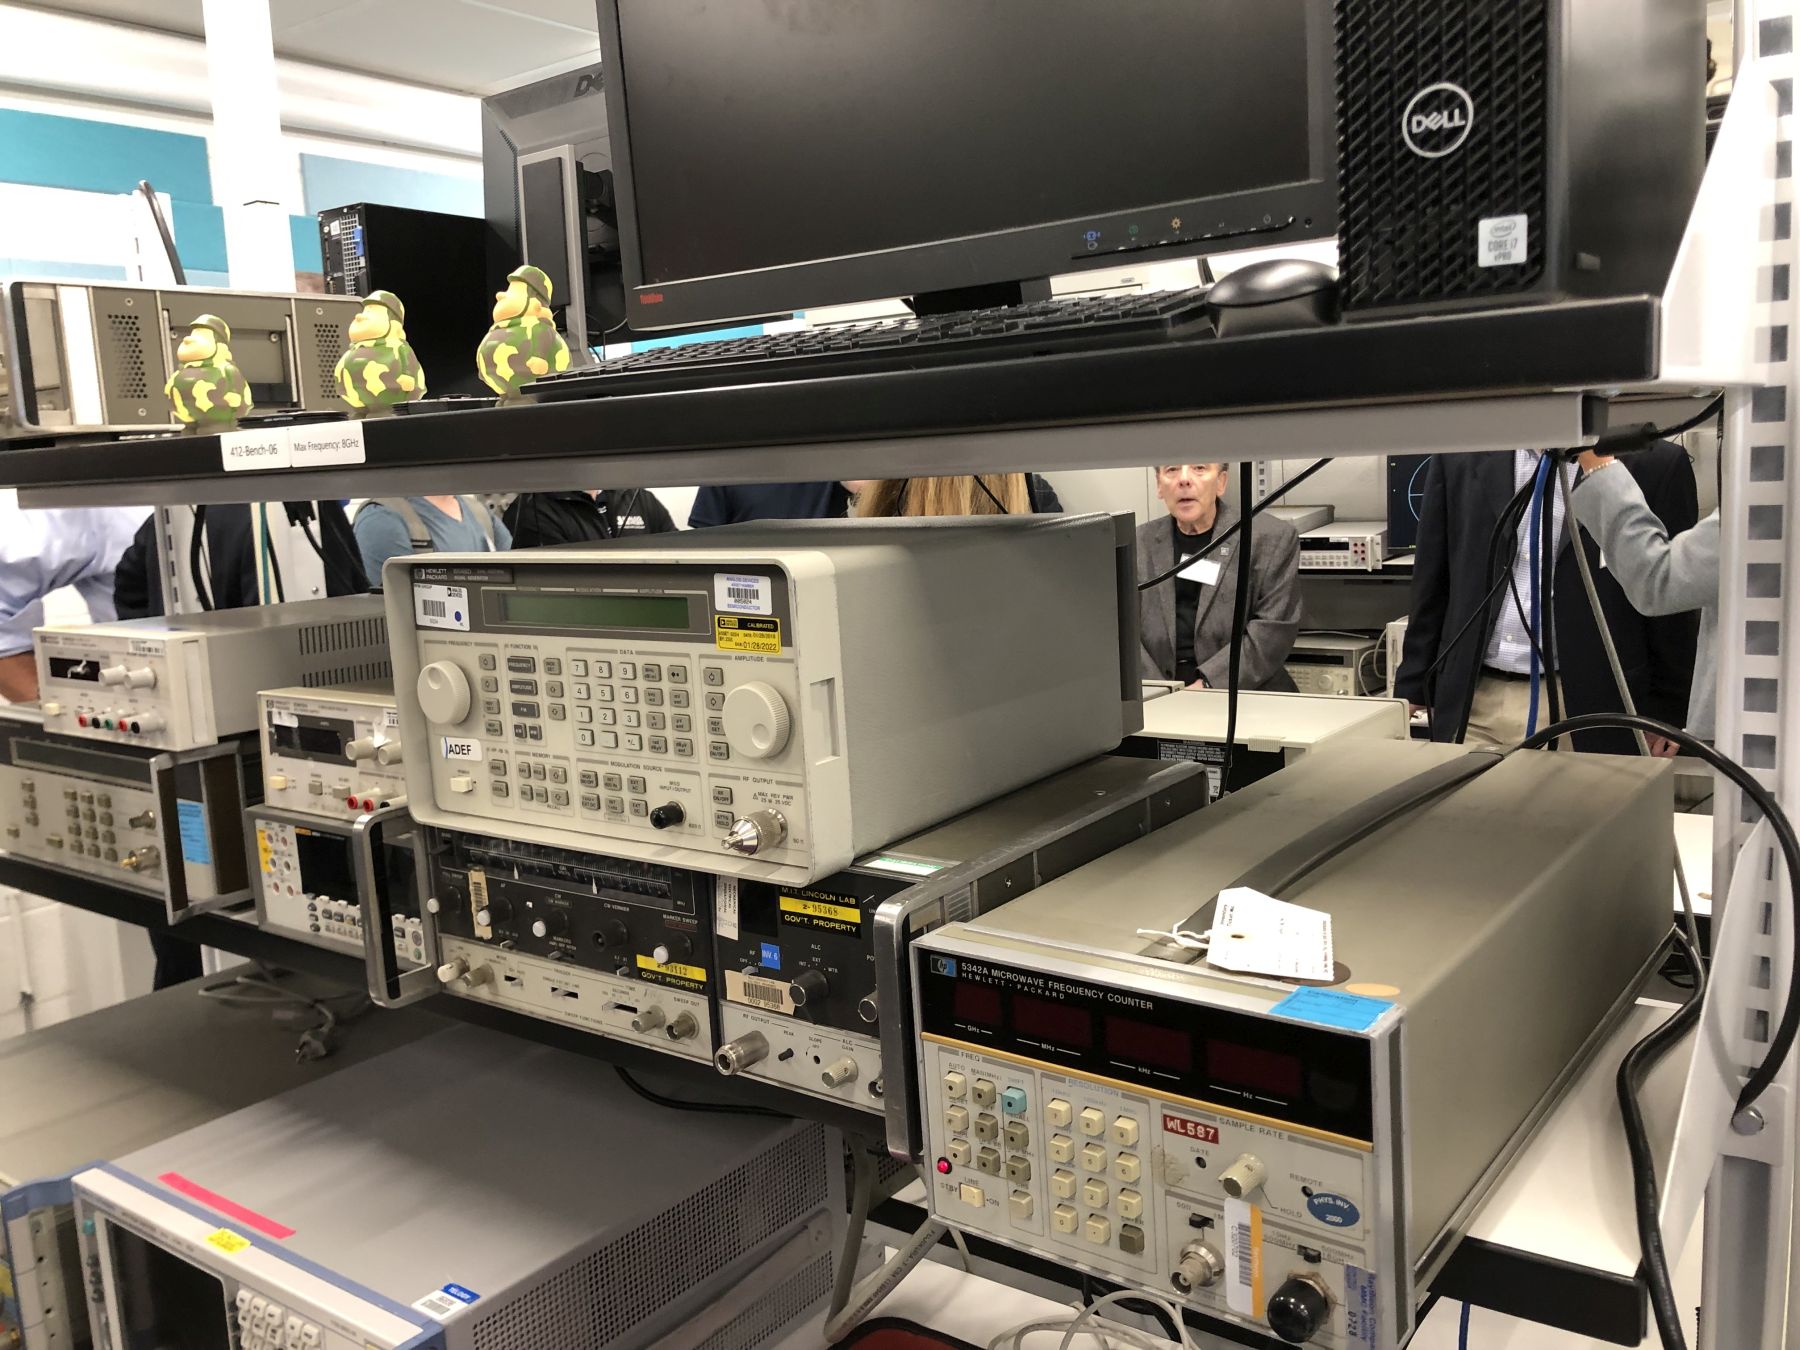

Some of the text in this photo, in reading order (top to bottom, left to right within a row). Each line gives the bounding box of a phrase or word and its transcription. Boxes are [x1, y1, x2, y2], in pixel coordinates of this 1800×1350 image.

[1411, 108, 1466, 134] DELL
[1487, 239, 1508, 252] CORE
[230, 443, 278, 457] 412-Bench-06
[294, 439, 359, 452] Max Frequency: 8GHz
[448, 744, 472, 756] ADEF
[610, 761, 640, 769] MODULATION
[752, 777, 773, 785] OUTPUT
[801, 890, 836, 902] LINCOLN
[838, 896, 856, 905] LAB
[682, 917, 698, 925] SWEEP
[813, 919, 857, 933] PROPERTY
[811, 943, 821, 951] ALC
[666, 977, 704, 990] PROPERTY
[961, 972, 1065, 999] HEWLETT PACKARD
[961, 962, 1153, 1010] 5342A MICROWAVE FREQUENCY COUNTER
[674, 996, 690, 1004] SWEEP
[564, 1011, 604, 1025] SWEEP FUNCTIONS
[750, 1015, 770, 1025] OUTPUT
[967, 1024, 980, 1033] GHz
[808, 1036, 822, 1044] SLOPE
[1041, 1042, 1055, 1052] MHz
[961, 1051, 980, 1062] FREQ
[948, 1062, 966, 1072] AUTO
[1138, 1066, 1151, 1075] kHz
[1068, 1077, 1120, 1096] RESOLUTION
[1242, 1090, 1253, 1099] Hz
[1166, 1117, 1215, 1140] WL587
[1219, 1117, 1284, 1140] SAMPLE RATE
[1190, 1146, 1210, 1156] GATE
[964, 1177, 980, 1186] LINE
[1289, 1173, 1323, 1187] REMOTE
[941, 1182, 959, 1192] STBY
[989, 1198, 1000, 1207] ON
[1335, 1199, 1350, 1209] INV
[1280, 1207, 1303, 1218] HOLD
